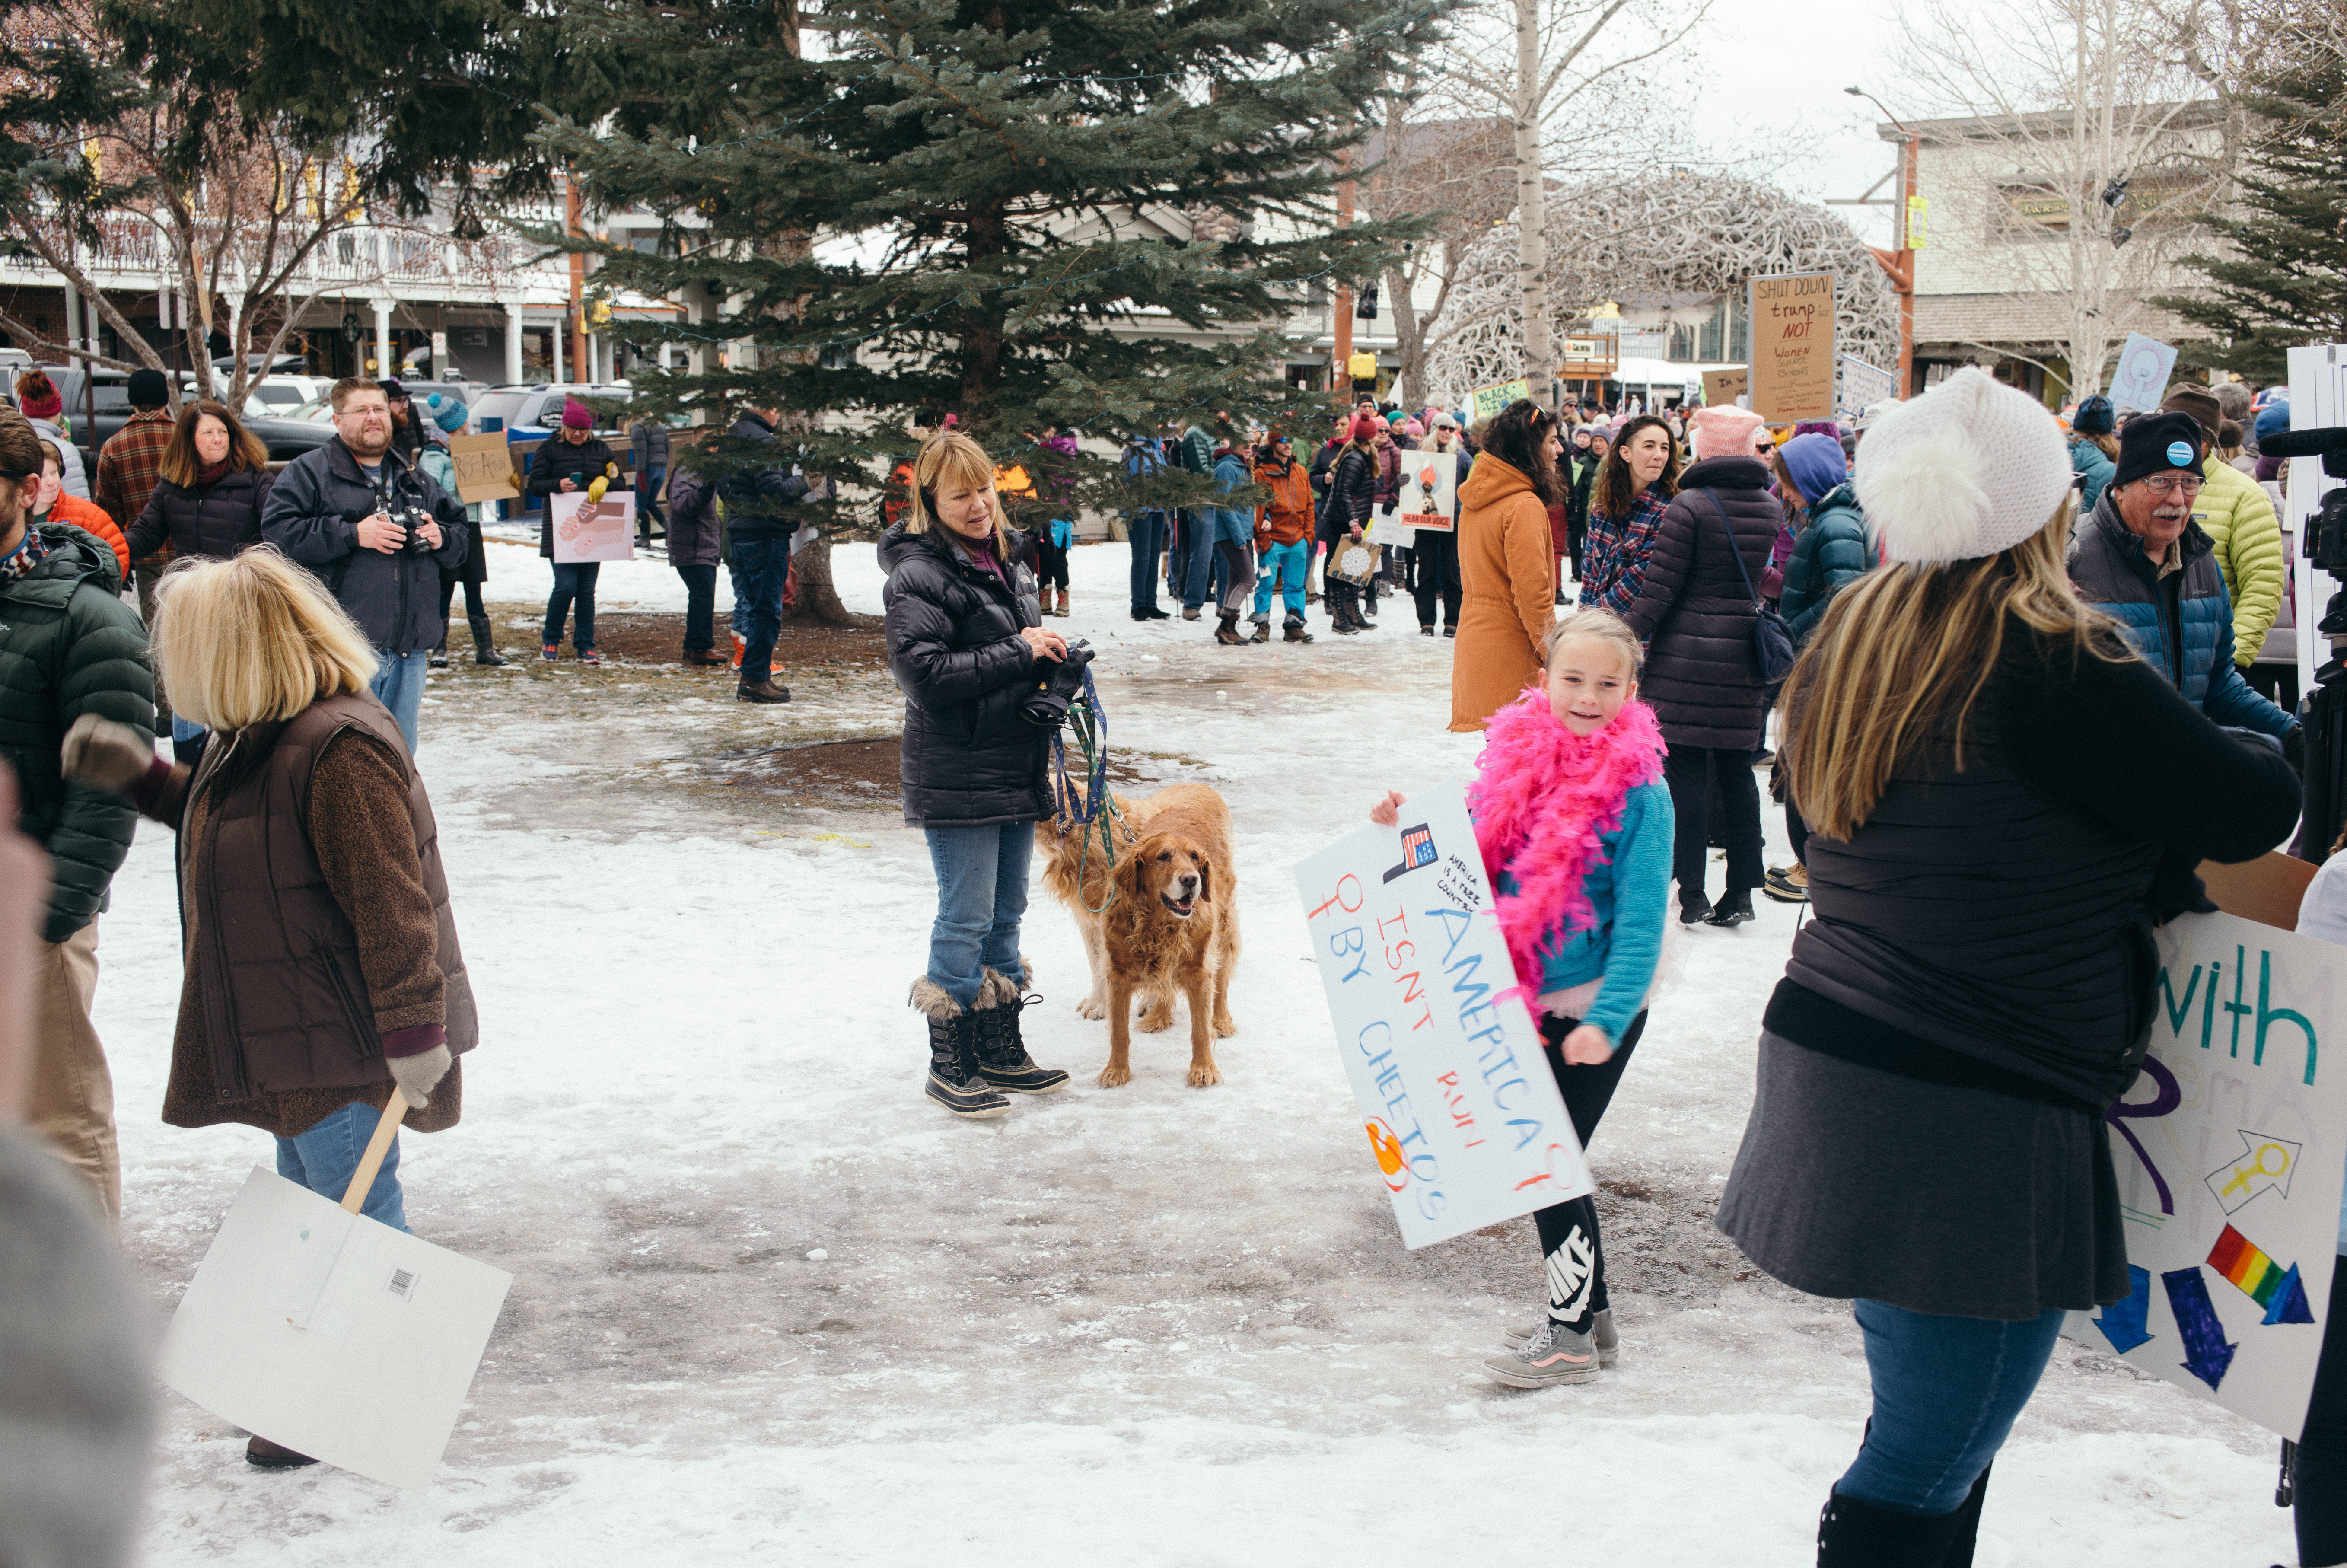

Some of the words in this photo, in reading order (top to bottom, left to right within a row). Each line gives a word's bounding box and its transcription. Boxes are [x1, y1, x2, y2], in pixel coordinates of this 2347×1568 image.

[1758, 280, 1791, 299] SHUT
[1795, 276, 1828, 296] DOWN
[1771, 303, 1815, 321] trump
[1783, 322, 1813, 338] NOT
[1775, 346, 1811, 358] WOMEN
[1478, 385, 1511, 403] BLACK
[1404, 514, 1420, 523] HEAR
[1433, 517, 1449, 526] VOICE
[1331, 570, 1369, 586] PROUD
[1448, 854, 1477, 886] AMERICA
[1443, 865, 1451, 877] IS
[1451, 876, 1457, 886] A
[1459, 883, 1480, 905] FREE
[1330, 924, 1371, 983] BY
[1425, 908, 1543, 1151] AMERICA
[1437, 1070, 1486, 1149] RUN
